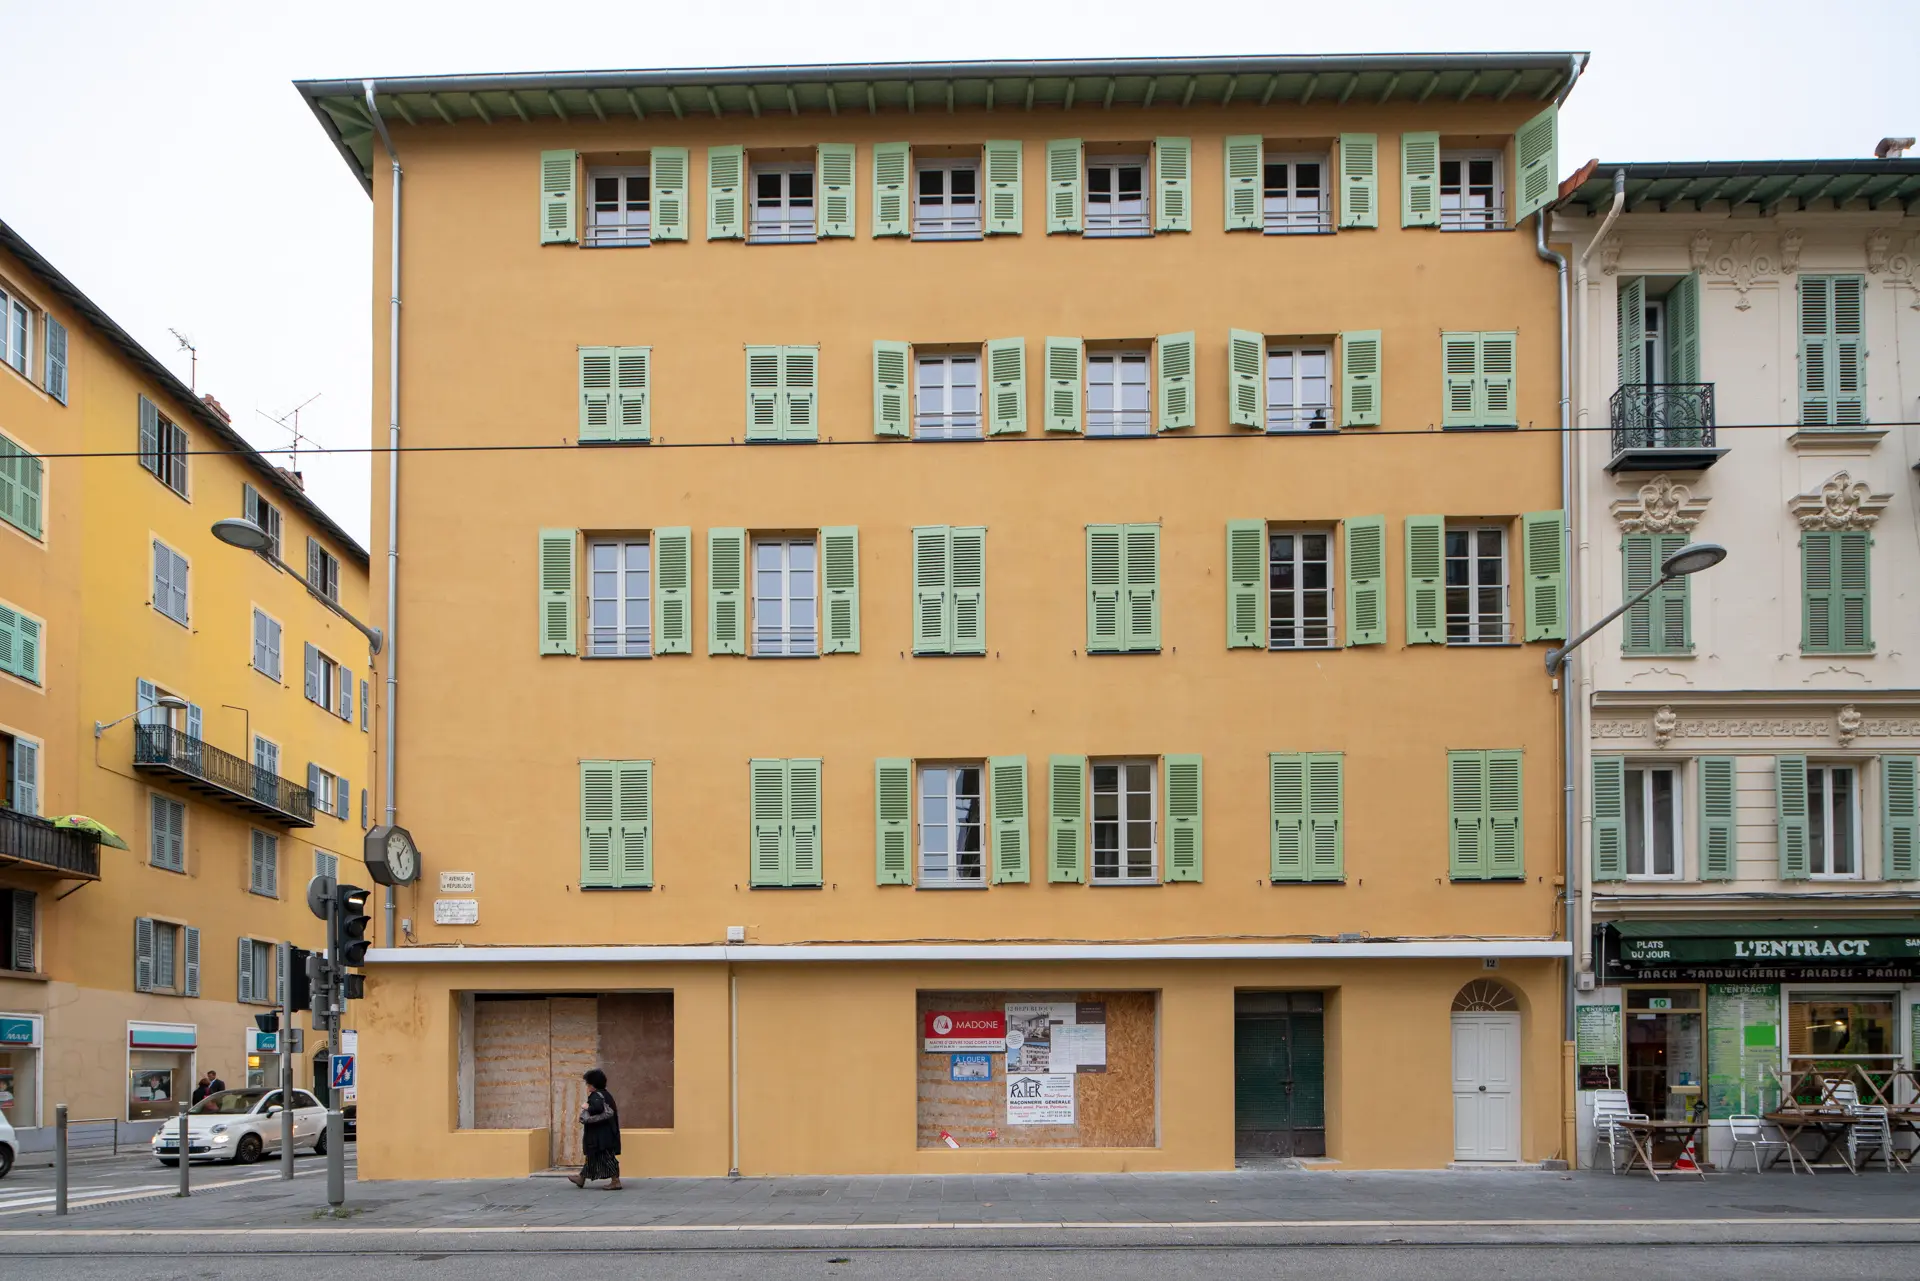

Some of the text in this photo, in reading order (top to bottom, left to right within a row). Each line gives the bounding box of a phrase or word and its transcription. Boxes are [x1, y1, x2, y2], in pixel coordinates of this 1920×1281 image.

[1637, 941, 1664, 949] PLATS
[1734, 940, 1870, 957] L'ENTRACT
[1646, 950, 1670, 958] JOUR
[1486, 959, 1495, 967] 12
[1638, 969, 1677, 979] SNACK
[1691, 969, 1786, 979] SANDWICHERIE
[1800, 968, 1853, 978] SALADES
[1867, 968, 1912, 977] PANINI
[1654, 999, 1666, 1008] 10
[956, 1020, 998, 1029] MADONE
